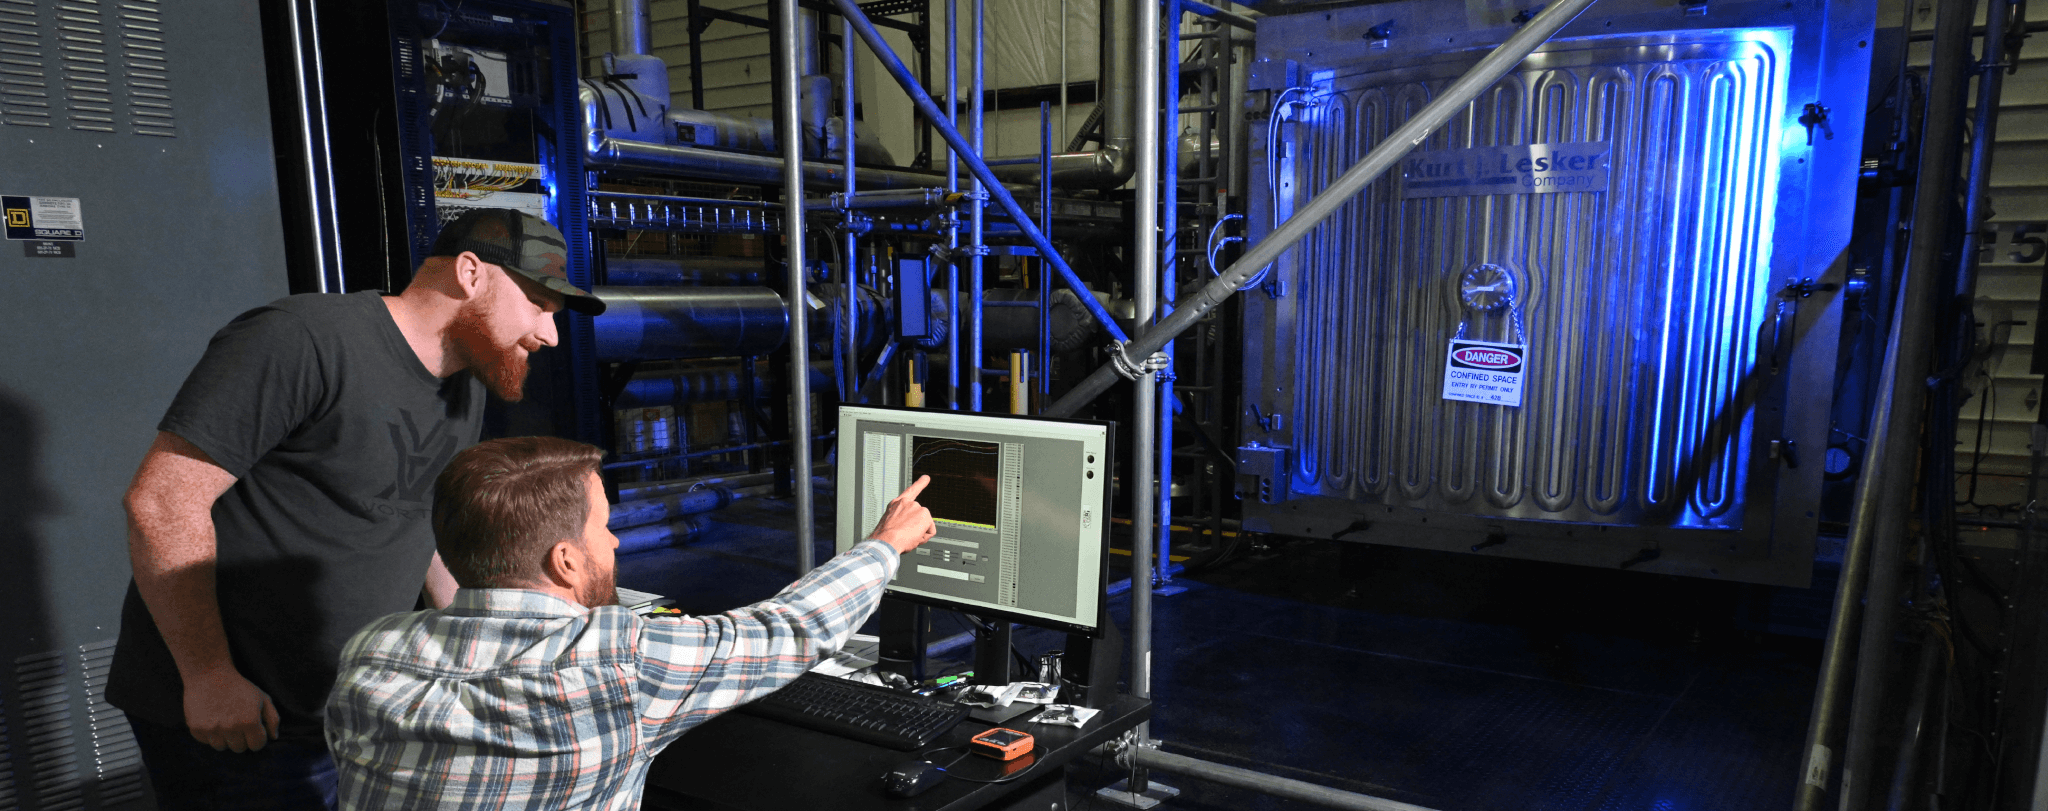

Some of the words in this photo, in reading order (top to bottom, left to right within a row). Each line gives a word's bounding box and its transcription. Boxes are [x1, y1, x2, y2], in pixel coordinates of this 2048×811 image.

[1409, 157, 1465, 178] Kurt
[1500, 150, 1600, 174] Lesker
[1521, 171, 1595, 188] Company
[1464, 350, 1509, 365] DANGER
[1450, 370, 1490, 382] CONFINED
[1492, 374, 1518, 385] SPACE
[1479, 384, 1498, 392] PERMIT
[362, 501, 432, 521] VORT
